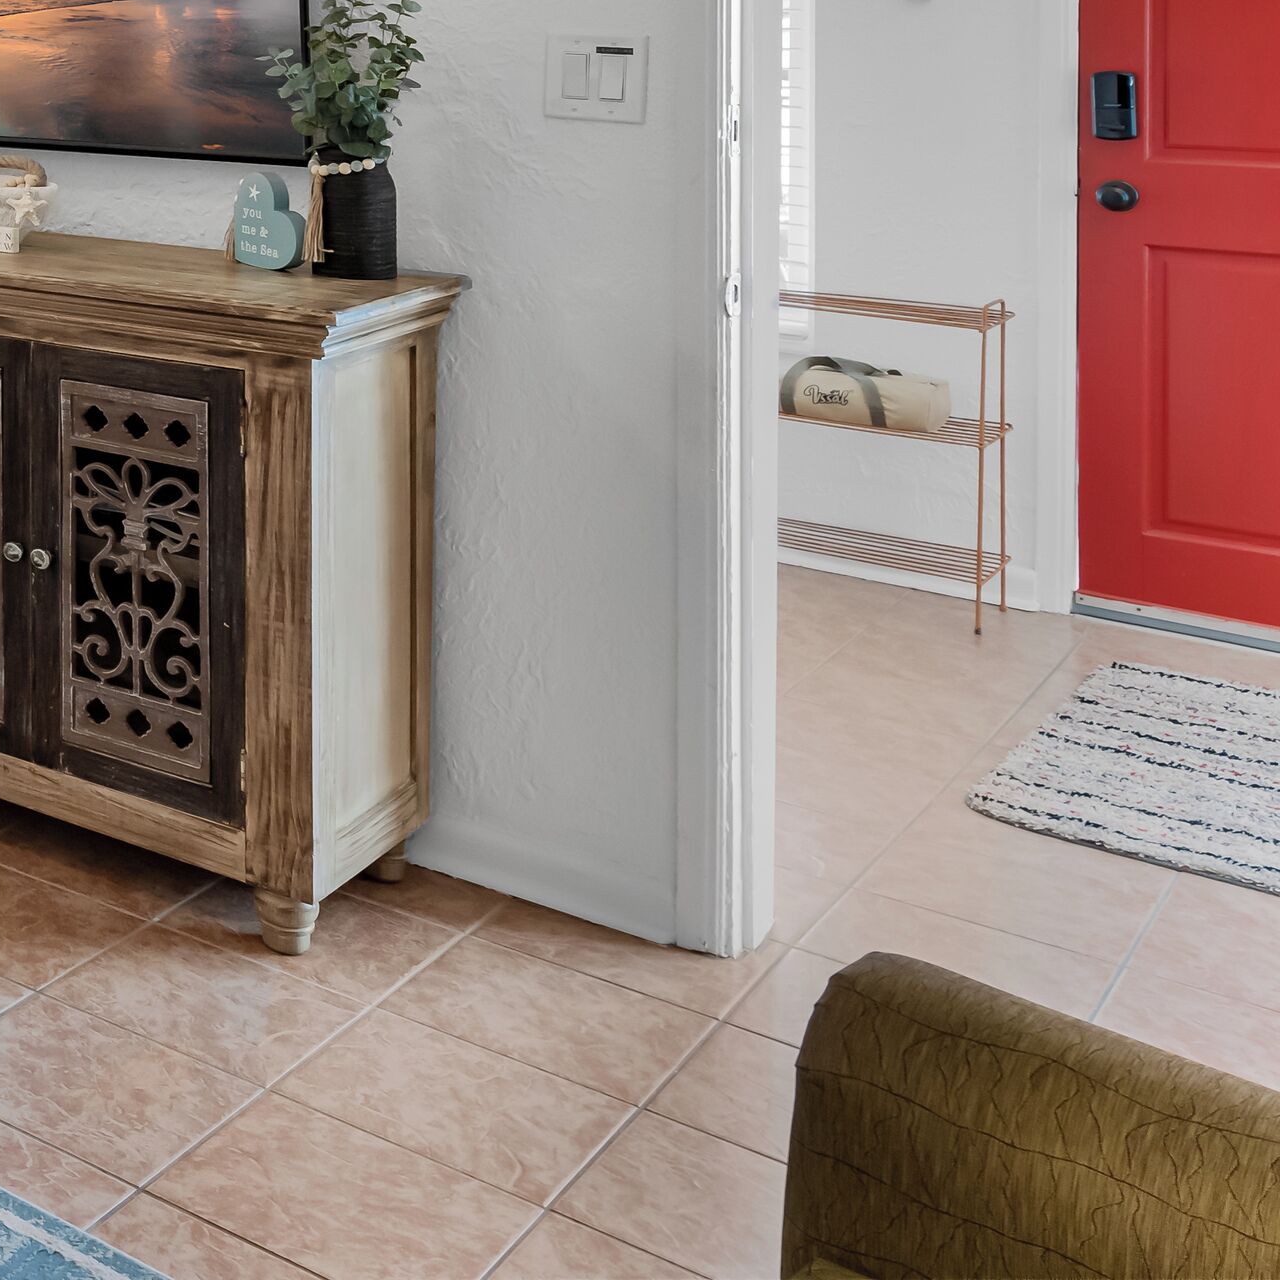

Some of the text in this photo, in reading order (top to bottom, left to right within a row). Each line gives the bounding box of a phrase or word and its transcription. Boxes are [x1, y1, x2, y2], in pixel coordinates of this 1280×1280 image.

[242, 207, 262, 220] you
[241, 225, 269, 238] me &
[240, 241, 279, 258] the Sea
